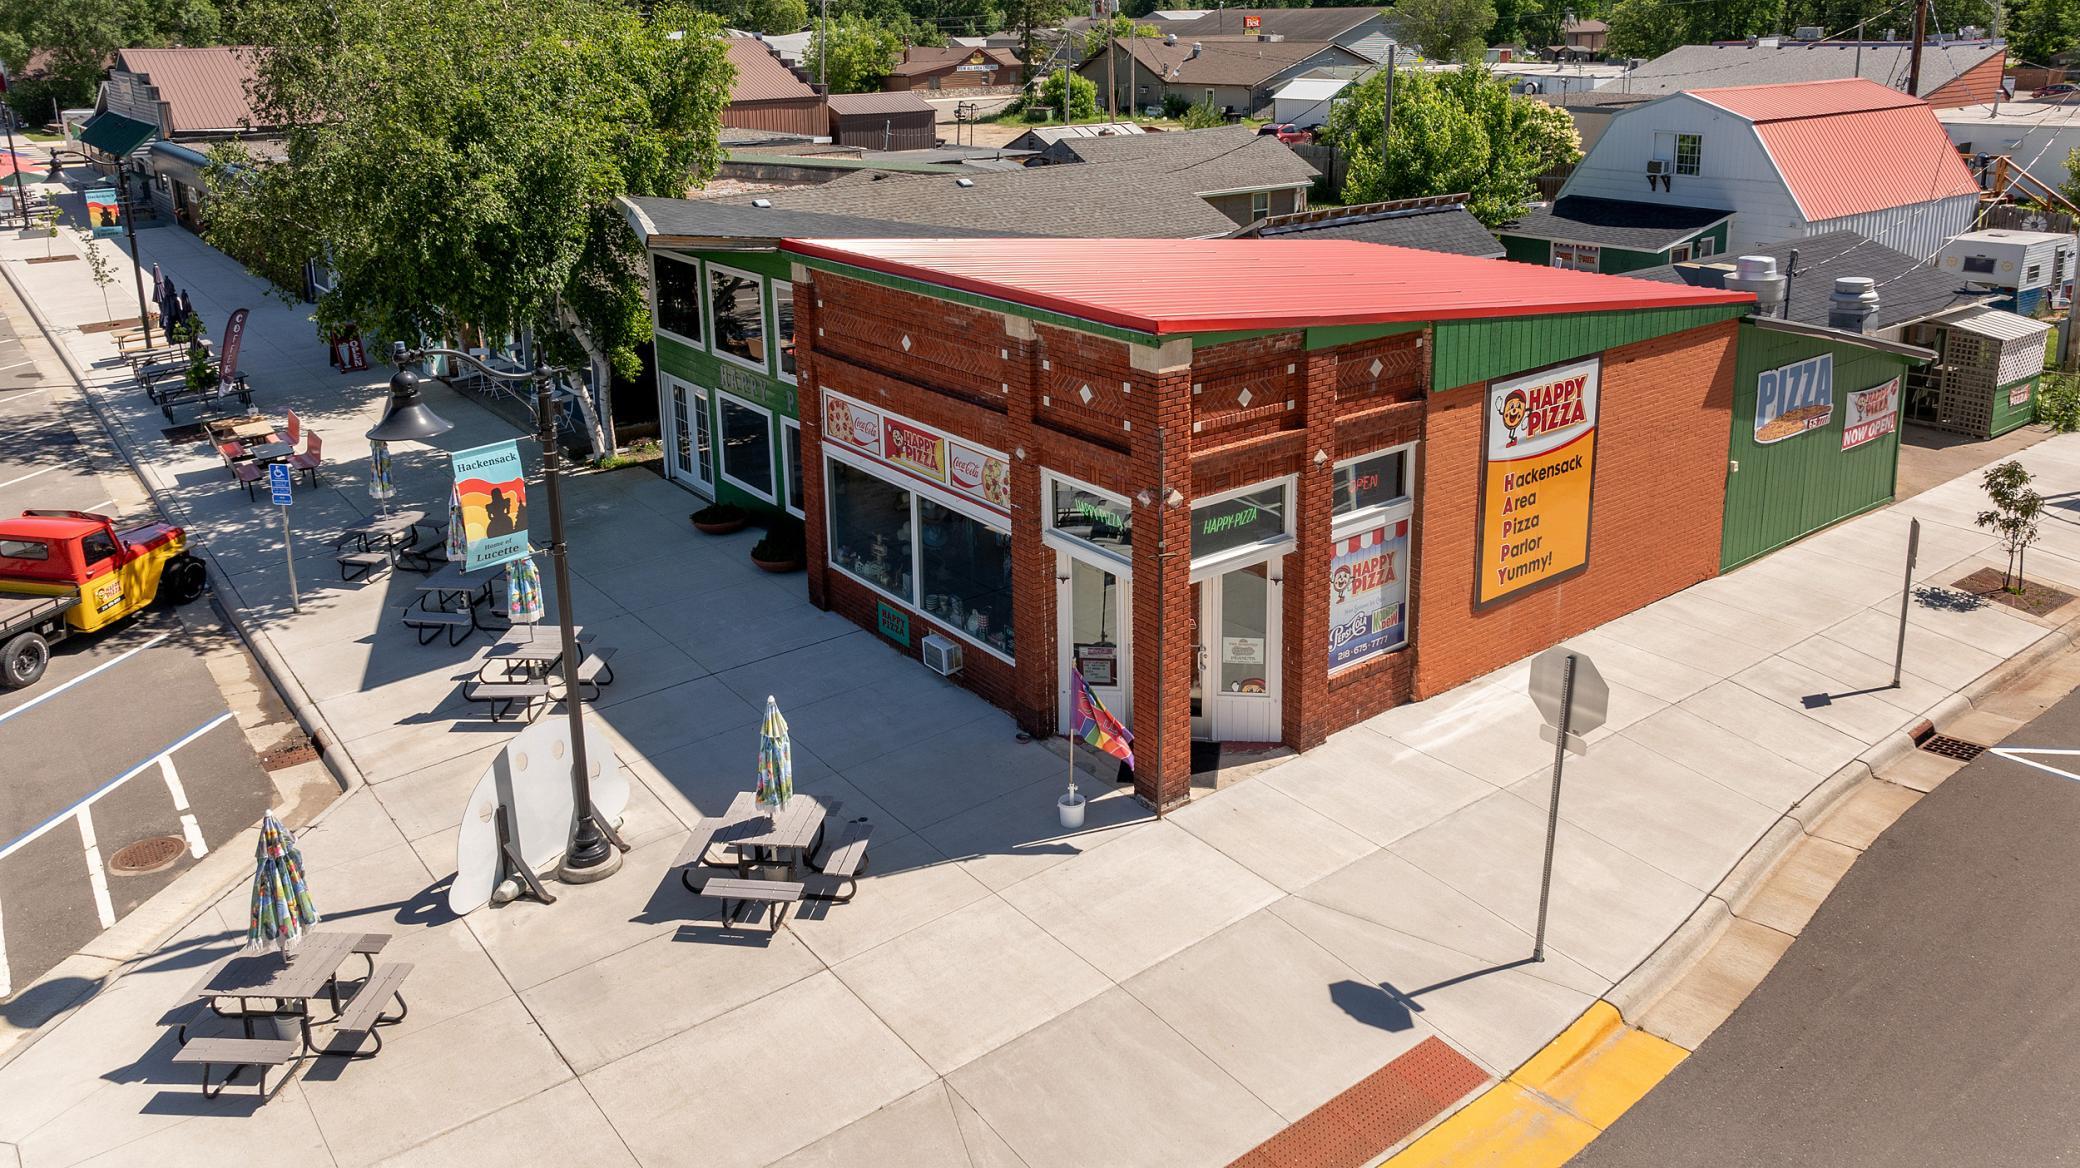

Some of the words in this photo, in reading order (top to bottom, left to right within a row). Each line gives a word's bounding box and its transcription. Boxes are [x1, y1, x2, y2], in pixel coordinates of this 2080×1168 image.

[224, 313, 243, 374] COFFEE
[720, 365, 767, 401] HAPPY
[1528, 375, 1587, 410] HAPPY
[1757, 356, 1831, 428] PIZZA
[1867, 387, 1889, 403] HAPPY
[1527, 400, 1587, 437] PIZZA
[1866, 397, 1889, 416] PIZZA
[904, 430, 937, 451] HAPPY
[1843, 424, 1867, 446] NOW
[1868, 414, 1895, 438] OPEN!
[457, 452, 517, 473] Hackensack
[905, 444, 939, 471] PIZZA
[1349, 474, 1378, 493] OPEN
[1504, 454, 1583, 492] Hackensack
[1502, 492, 1537, 516] Area
[1502, 514, 1539, 539] Pizza
[477, 543, 520, 562] Lucette
[484, 541, 503, 551] Home
[1500, 536, 1543, 563] Parlor
[1352, 550, 1395, 577] HAPPY
[1498, 551, 1552, 586] Yummy!
[1352, 566, 1396, 594] PIZZA
[881, 609, 904, 626] HAPPY
[882, 617, 905, 637] PIZZA
